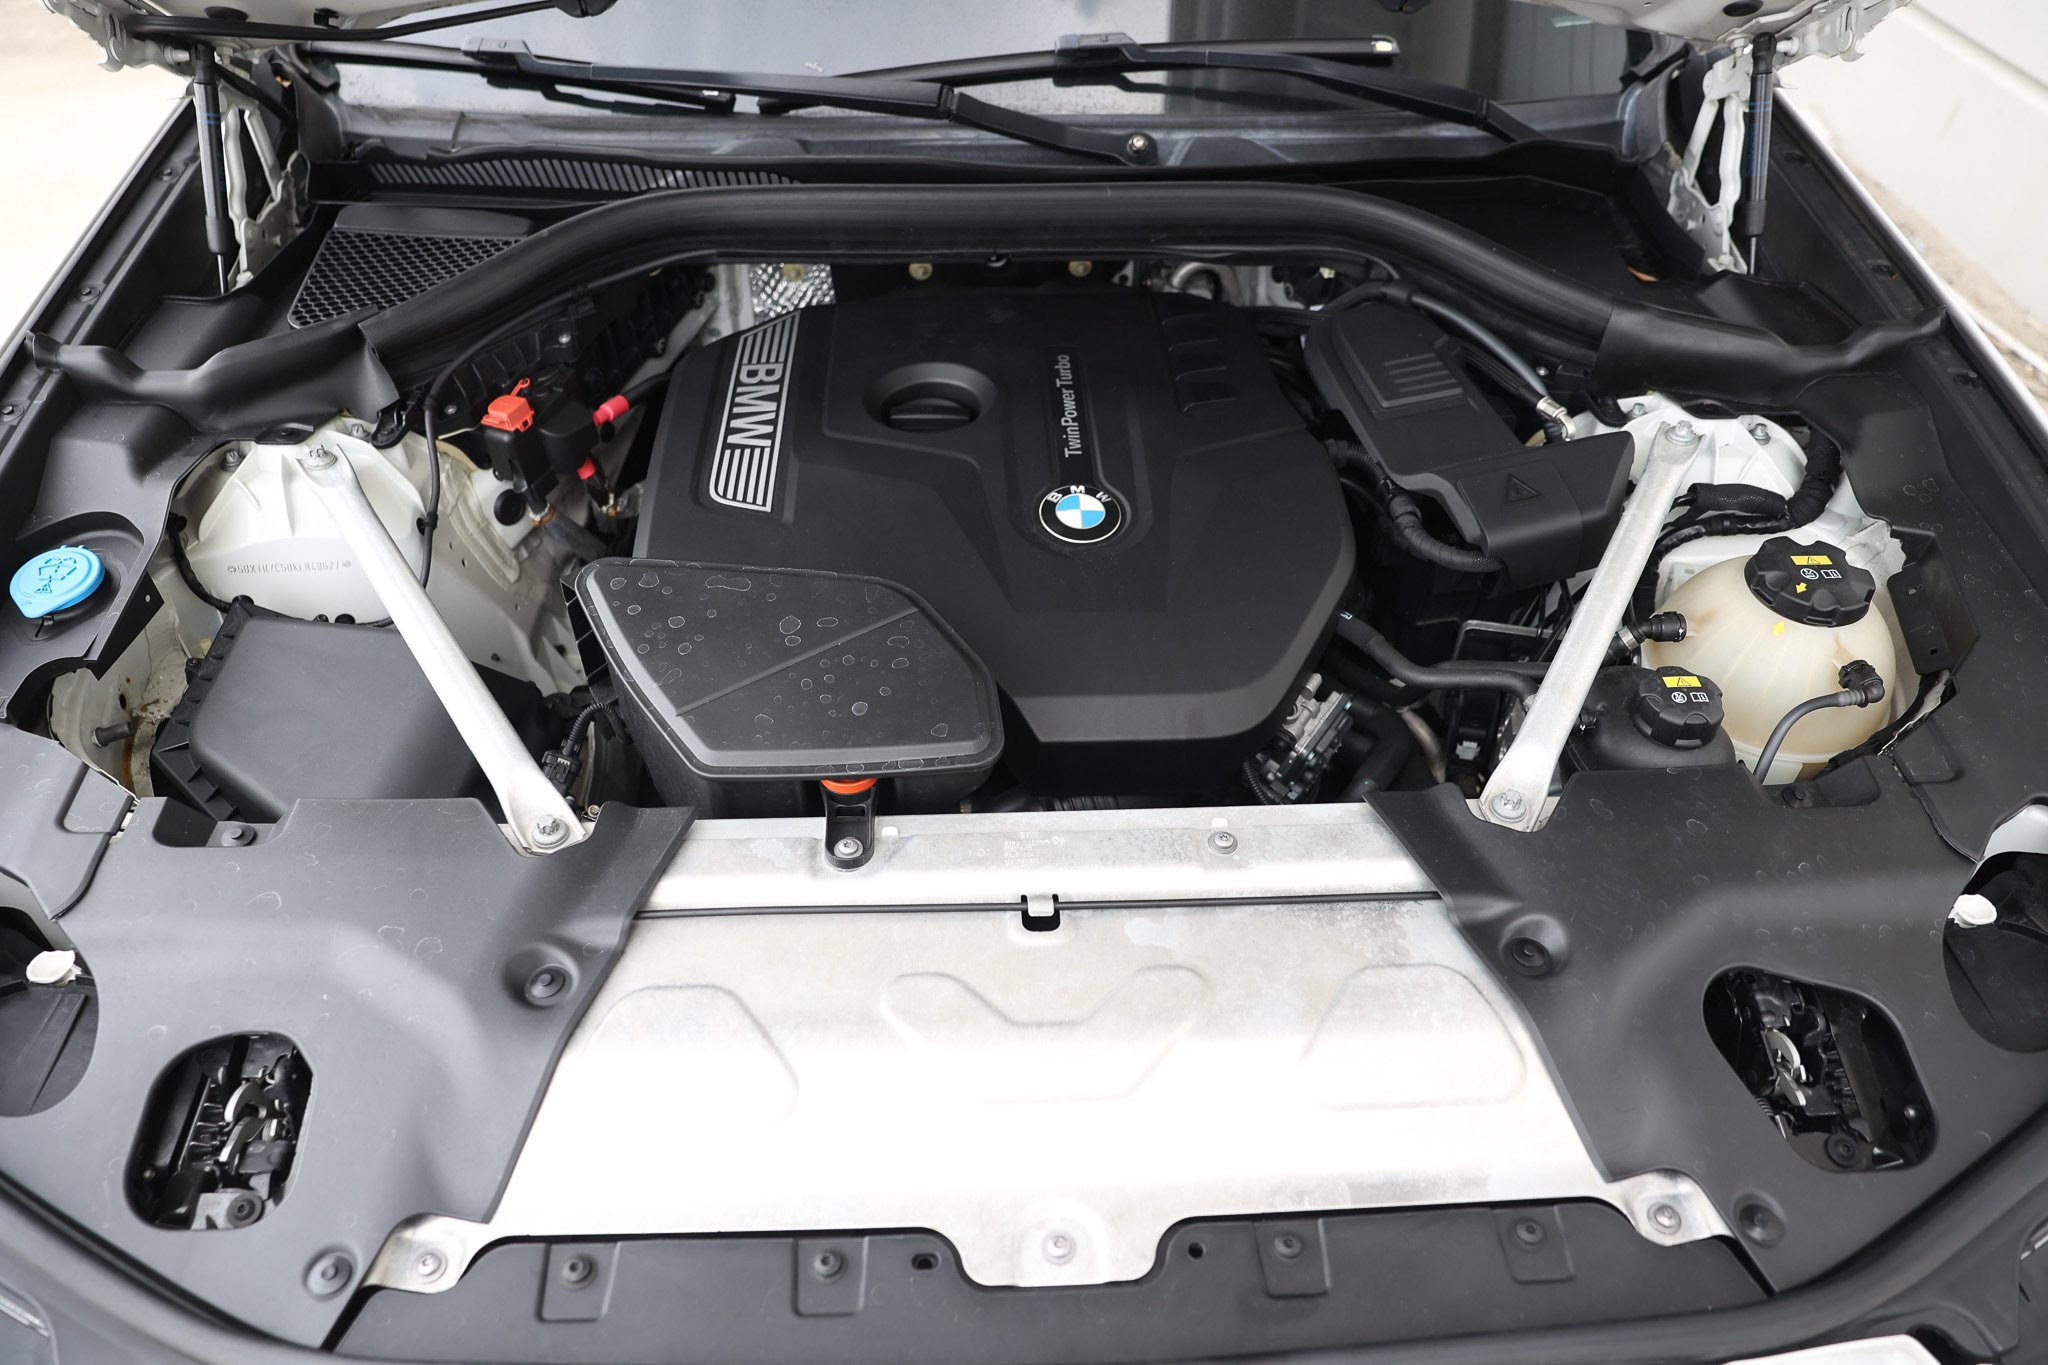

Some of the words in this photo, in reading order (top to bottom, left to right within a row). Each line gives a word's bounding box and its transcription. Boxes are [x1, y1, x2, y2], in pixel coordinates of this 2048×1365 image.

[1054, 354, 1073, 388] Turbo
[727, 363, 784, 447] BMW
[1061, 388, 1082, 458] TwinPower
[1046, 485, 1111, 504] BMW
